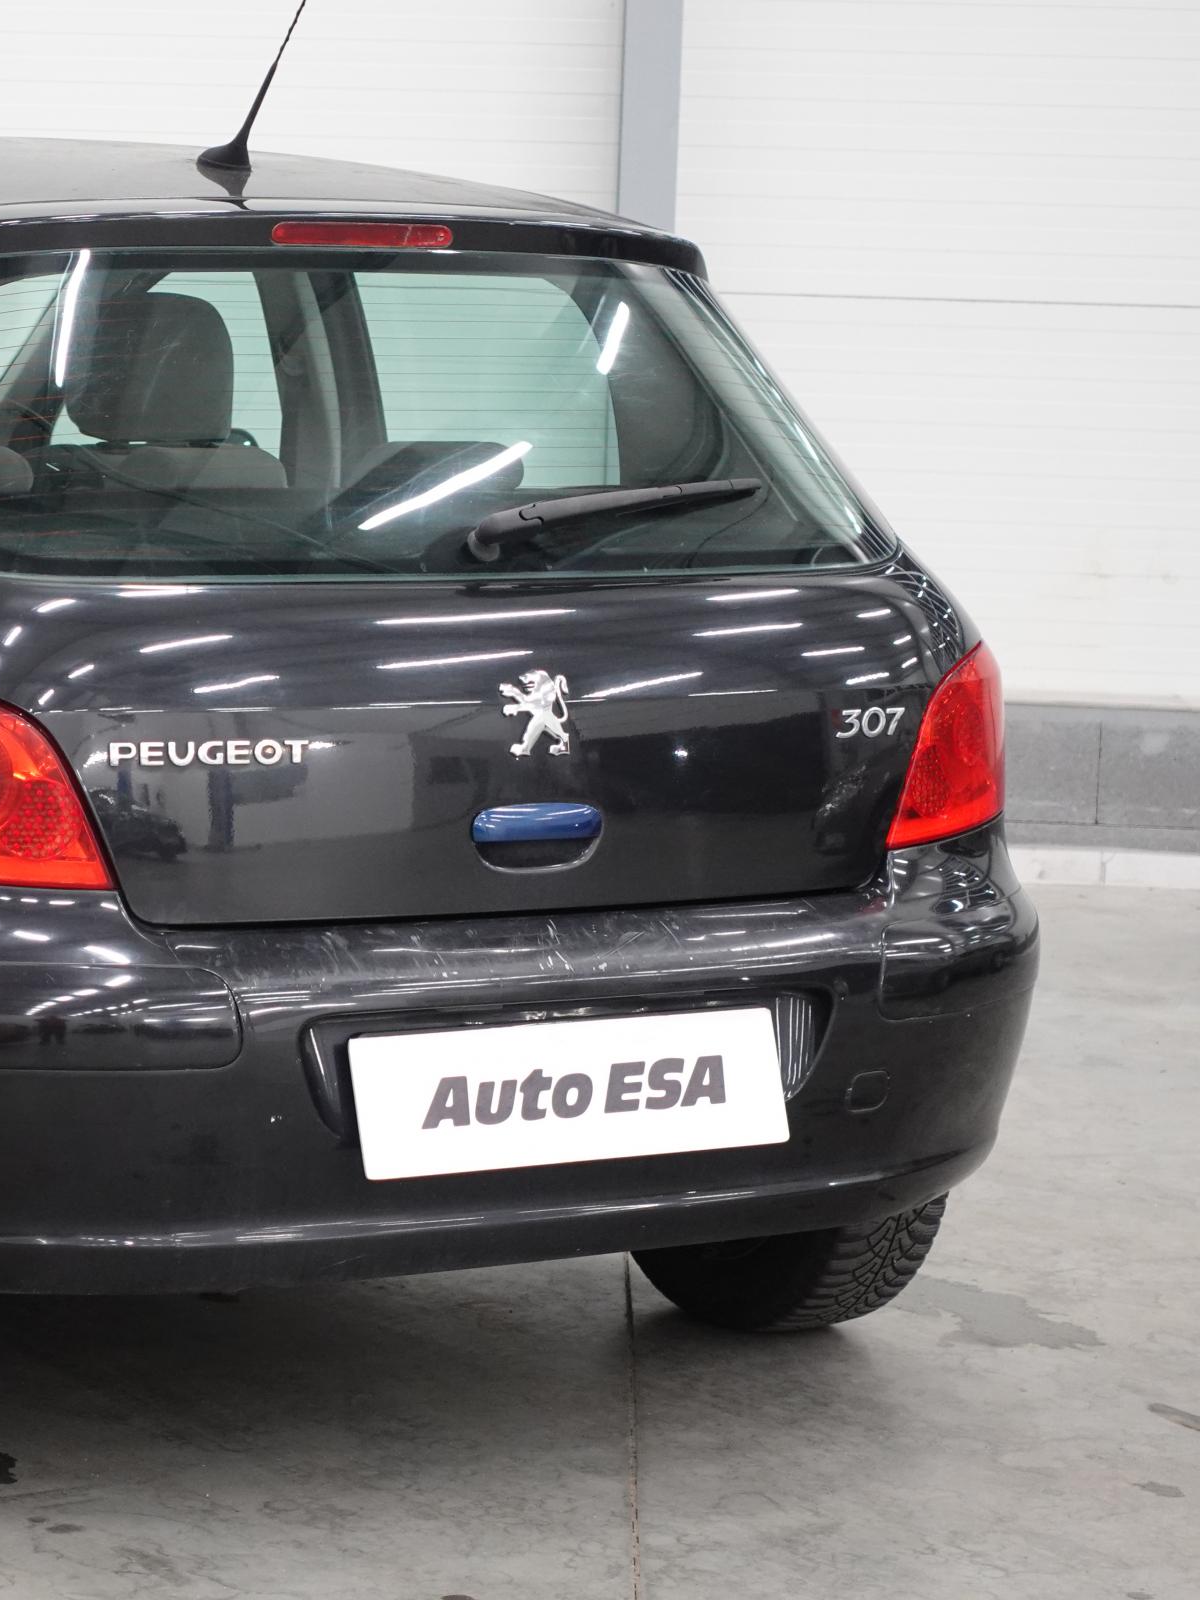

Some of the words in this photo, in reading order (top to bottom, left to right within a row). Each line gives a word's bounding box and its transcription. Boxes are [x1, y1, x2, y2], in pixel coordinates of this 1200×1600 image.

[836, 706, 905, 738] 307
[109, 738, 309, 767] PEUGEOT
[422, 1069, 593, 1129] Auto
[604, 1055, 726, 1113] ESA
